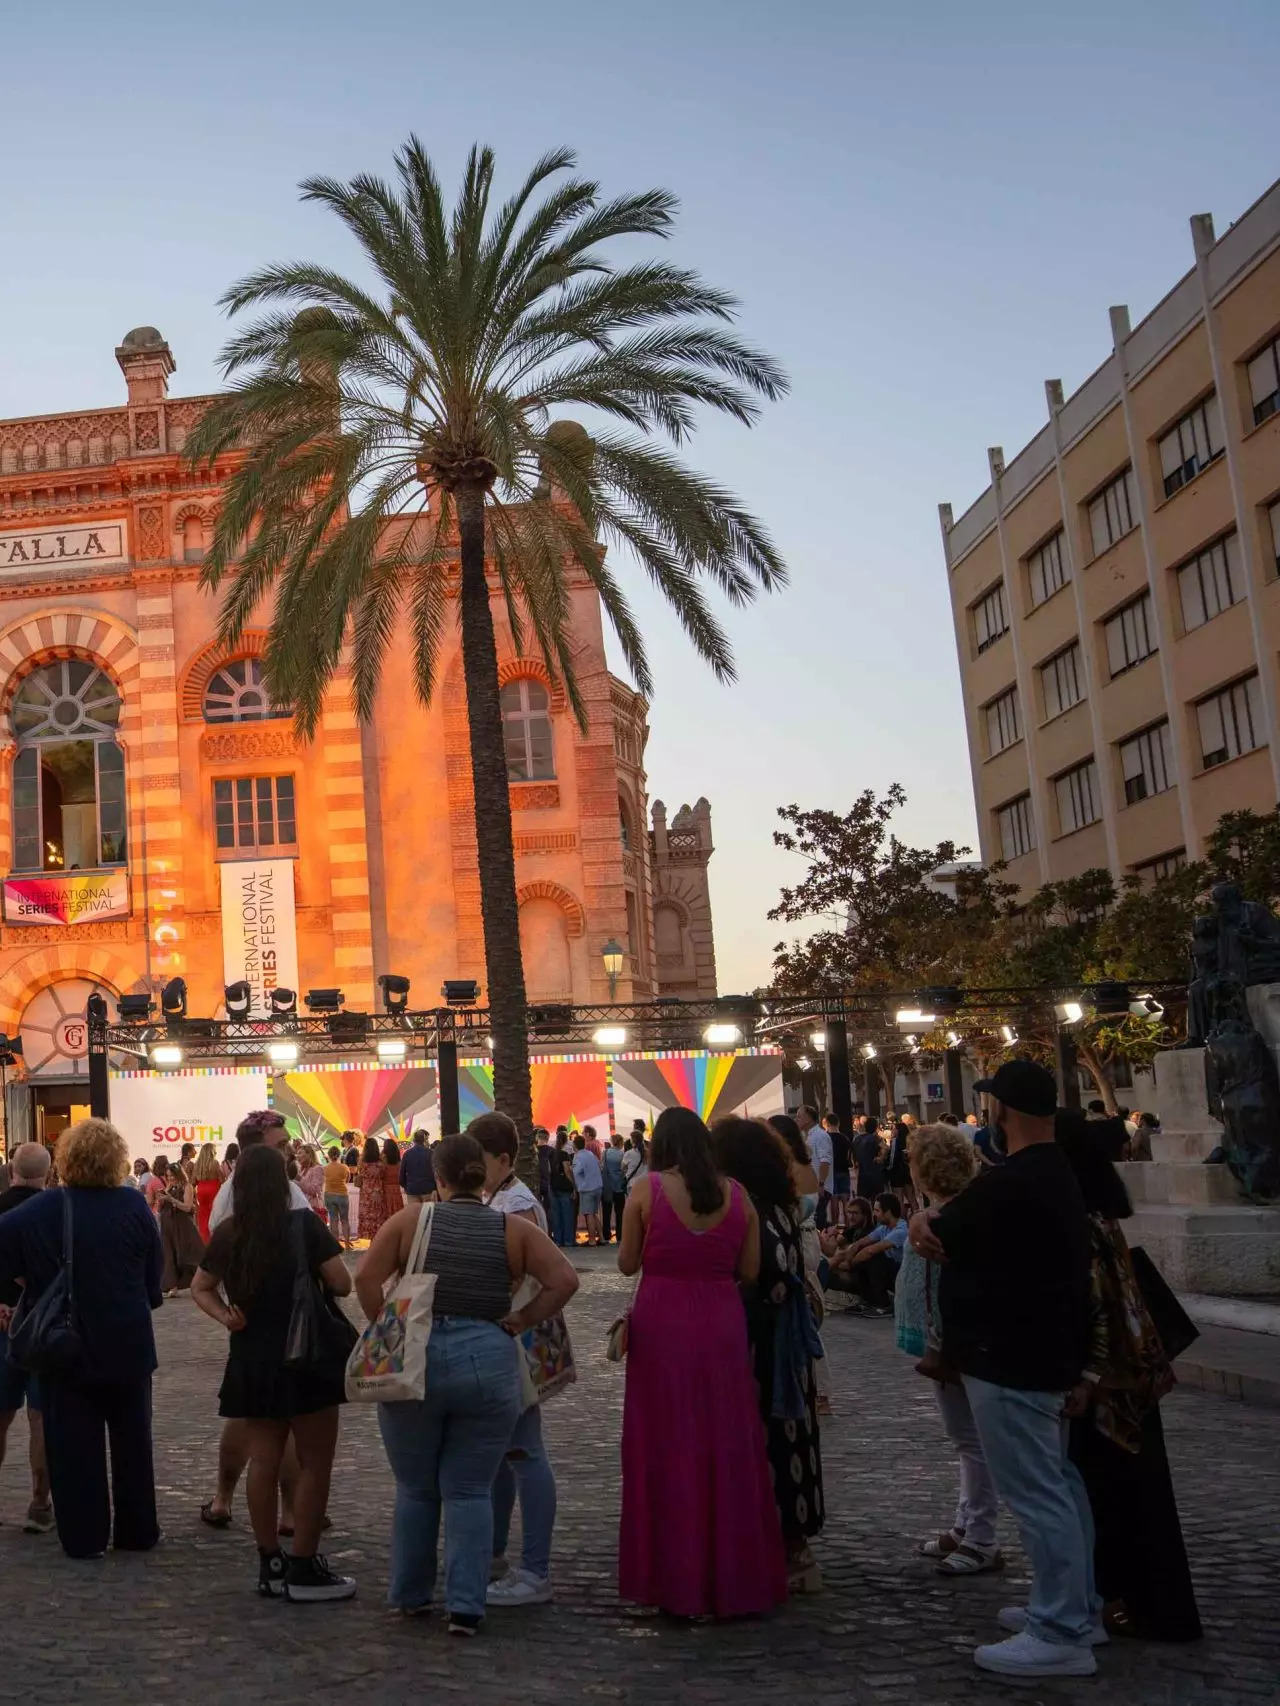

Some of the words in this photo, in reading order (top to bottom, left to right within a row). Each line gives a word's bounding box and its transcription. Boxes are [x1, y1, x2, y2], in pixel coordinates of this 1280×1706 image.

[17, 888, 114, 903] INTERNATIONAL
[18, 903, 59, 915] SERIES
[61, 900, 116, 913] FESTIVAL
[259, 868, 275, 944] FESTIVAL
[242, 871, 261, 1011] INTERNATIONAL
[152, 1125, 223, 1142] SOUTH
